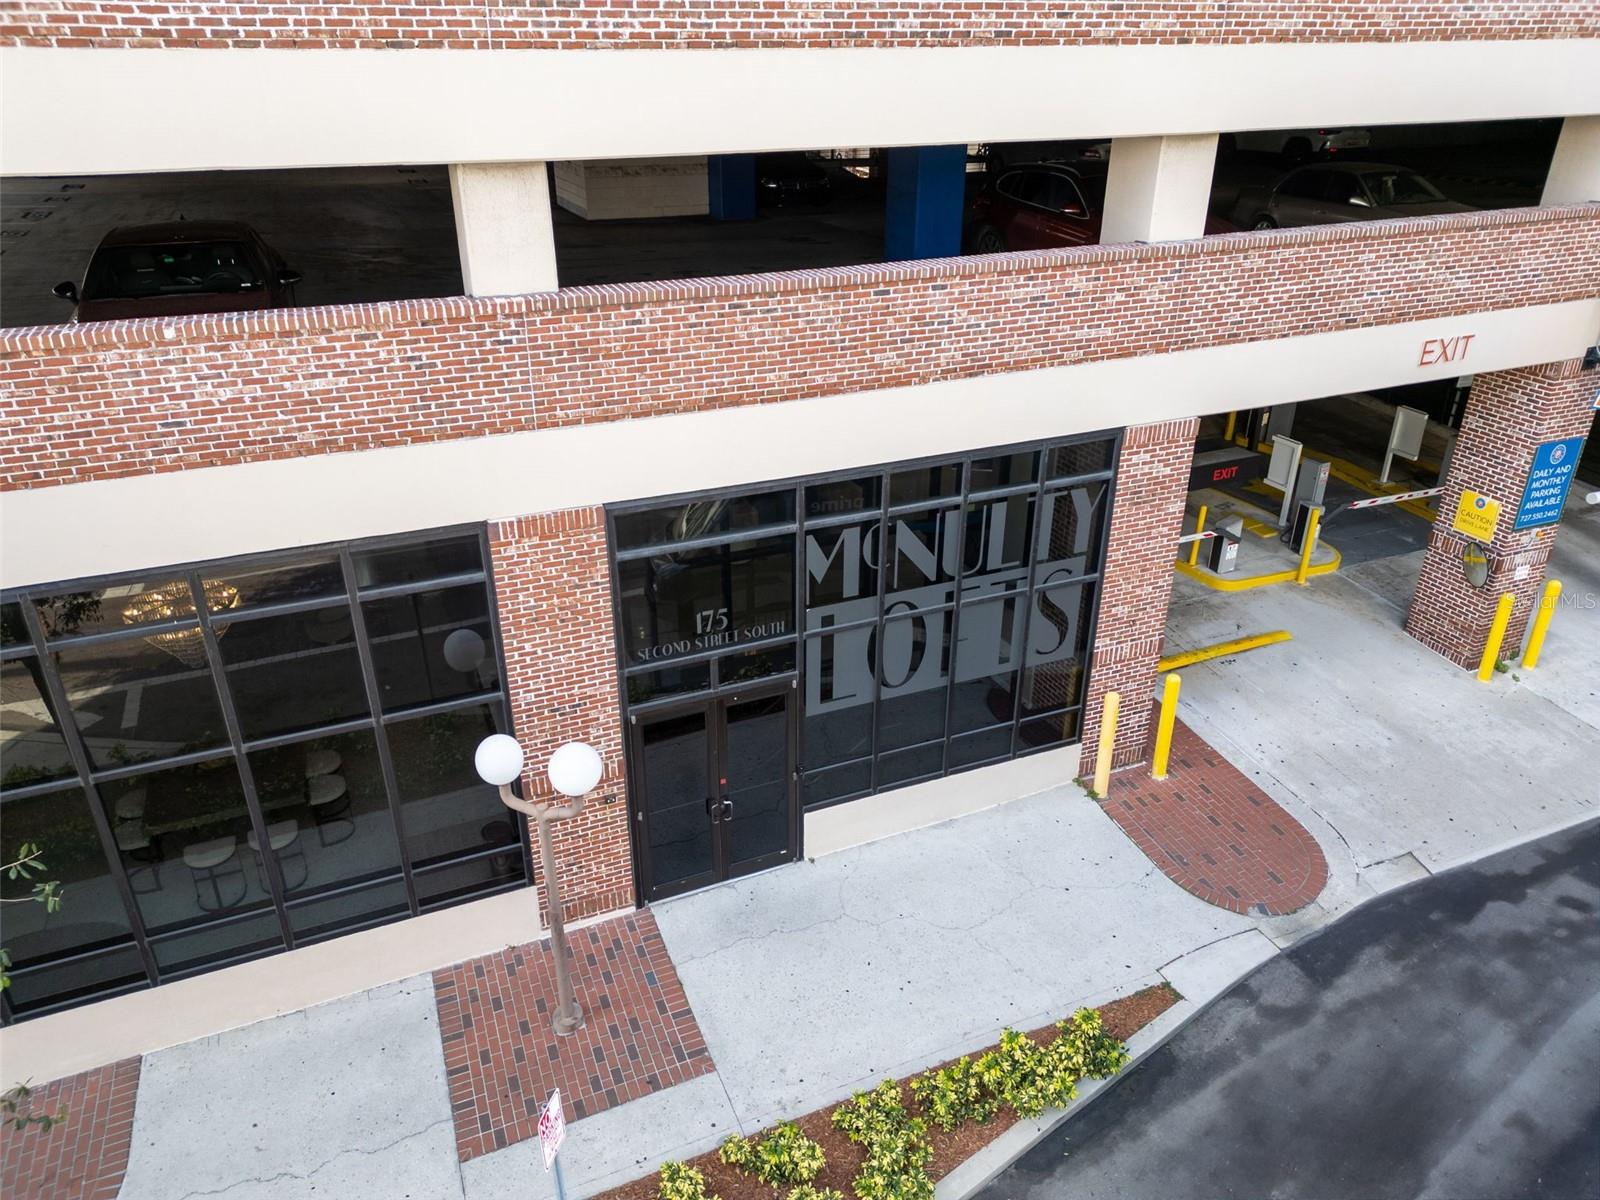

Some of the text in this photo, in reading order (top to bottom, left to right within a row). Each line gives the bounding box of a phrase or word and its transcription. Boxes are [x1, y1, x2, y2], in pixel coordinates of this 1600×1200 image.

[1418, 334, 1475, 366] EXIT
[1213, 466, 1239, 480] EXIT
[1533, 465, 1571, 478] DAILY AND
[1531, 475, 1567, 489] MONTHLY
[1531, 486, 1561, 499] PARKING
[1524, 496, 1561, 510] AVAILABLE
[1461, 508, 1492, 526] CAUTION
[696, 608, 729, 634] 175
[638, 621, 785, 660] SECOND STREET SOUTH
[820, 568, 1073, 704] LOFTS
